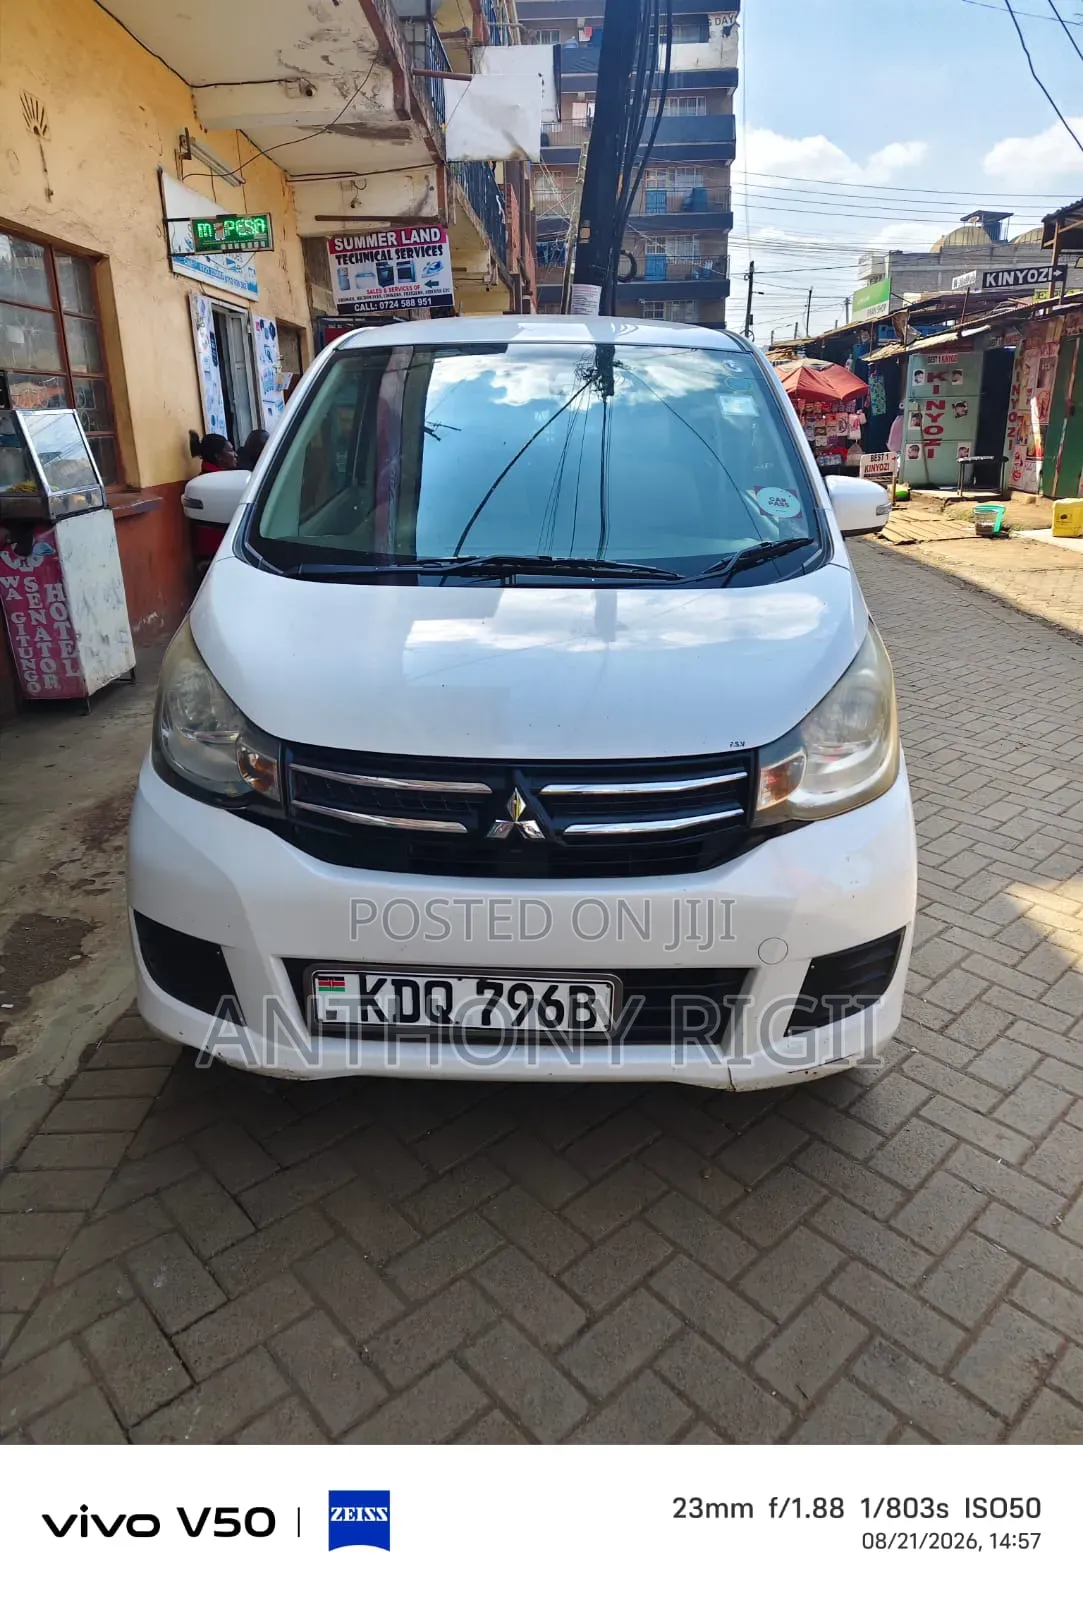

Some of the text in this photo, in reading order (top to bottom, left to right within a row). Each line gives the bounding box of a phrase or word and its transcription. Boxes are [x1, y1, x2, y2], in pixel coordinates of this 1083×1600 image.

[335, 228, 441, 250] SUMMER LAND
[335, 244, 443, 265] TECHNICAL SERVICES
[986, 267, 1052, 287] KINYOZI
[354, 298, 432, 312] CALL: 0724 588 951
[923, 371, 949, 459] KINYOZI
[865, 463, 890, 473] KINYOZI
[871, 454, 884, 462] BEST
[0, 576, 23, 600] WA
[23, 576, 60, 689] SENATOR
[44, 583, 81, 677] HOTEL
[11, 612, 41, 694] GITUNGO
[359, 974, 597, 1030] KDQ 796B
